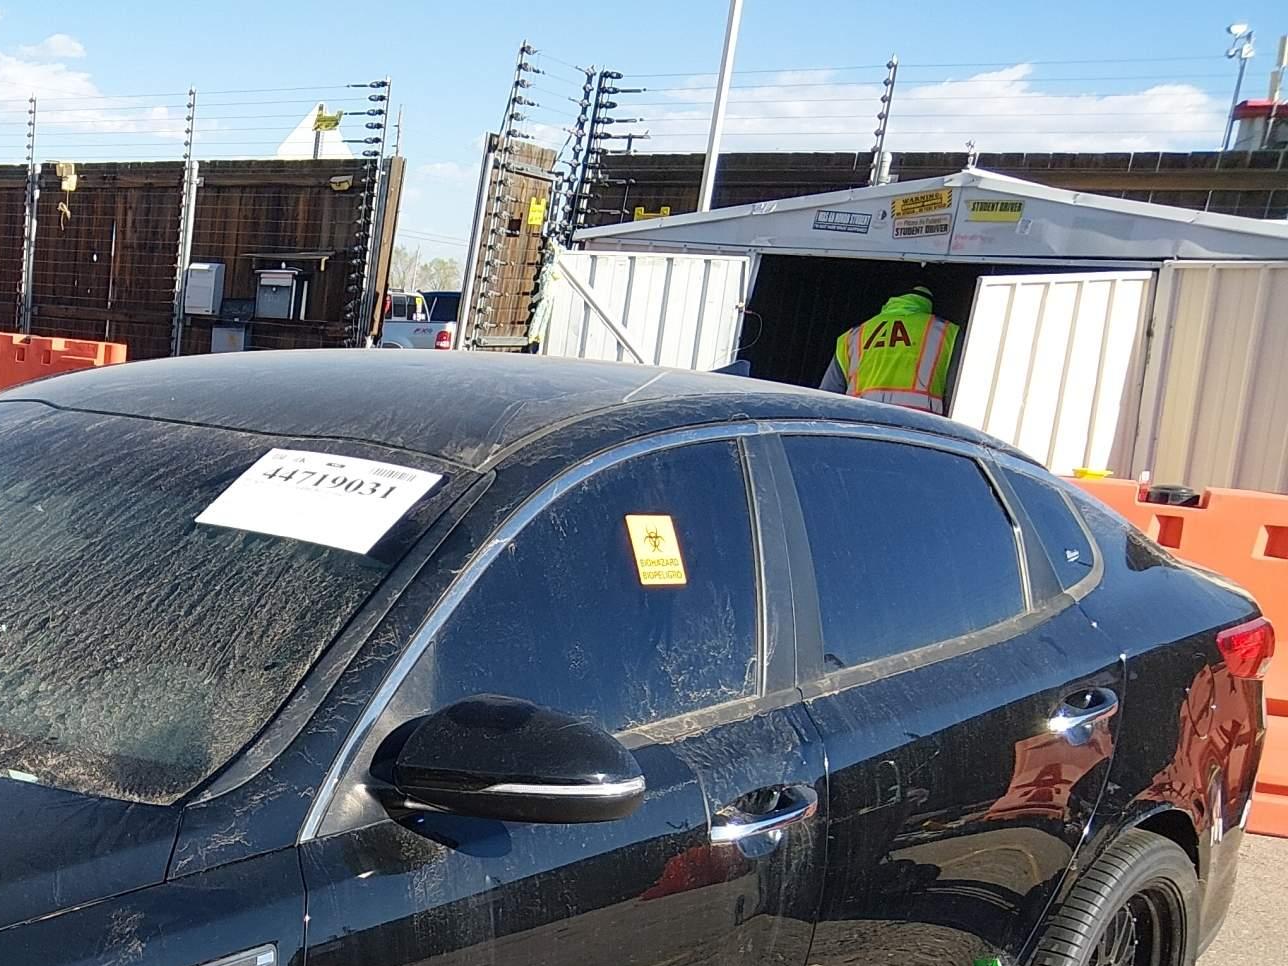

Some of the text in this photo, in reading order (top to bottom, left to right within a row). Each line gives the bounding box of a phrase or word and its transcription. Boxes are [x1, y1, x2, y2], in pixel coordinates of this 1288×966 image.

[971, 201, 1023, 212] STUDENT DRIVER
[894, 223, 948, 237] STUDENT DRIVER
[262, 466, 397, 499] 44719031
[639, 558, 680, 567] BIOHAZARD
[642, 571, 683, 580] BIOPELIGRO
